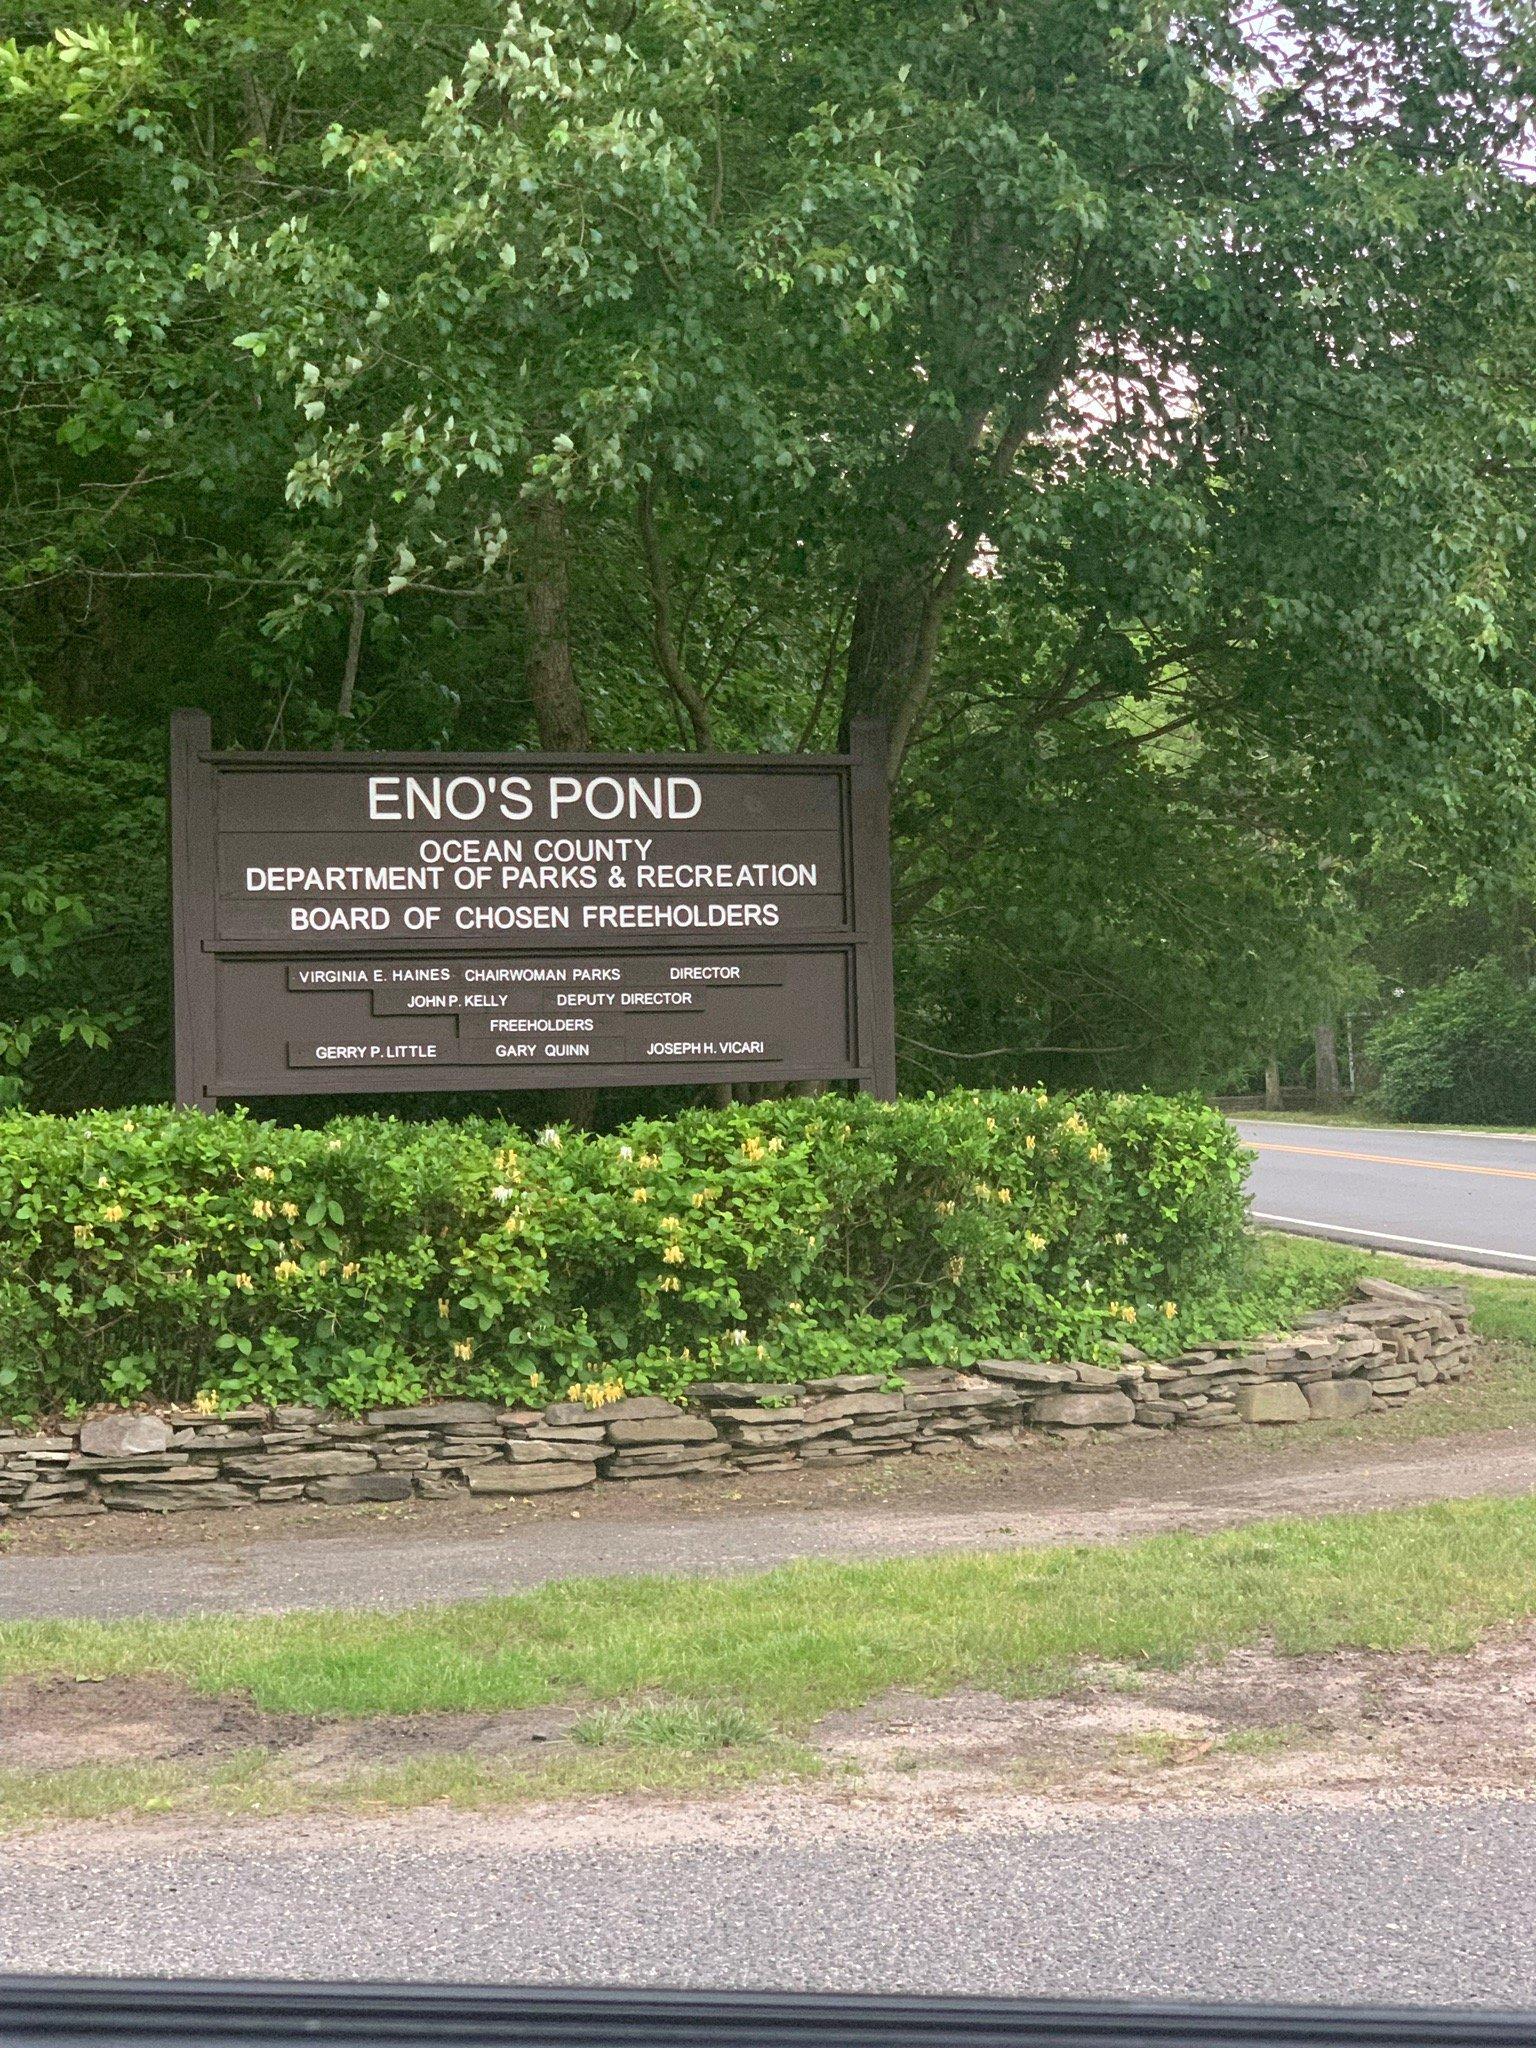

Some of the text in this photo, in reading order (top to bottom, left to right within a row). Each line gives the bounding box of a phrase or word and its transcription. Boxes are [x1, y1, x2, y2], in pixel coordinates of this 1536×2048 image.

[369, 777, 702, 820] ENO'S POND
[420, 839, 653, 863] OCEAN COUNTY
[247, 864, 816, 891] DEPARTMENT OF PARKS & RECREATION
[291, 904, 780, 930] BOARD OF CHOSEN FREEHOLDERS
[299, 967, 741, 983] VIRGINIA E. HAINES CHAIRWOMAN PARKS DIRECTOR
[407, 992, 692, 1008] JOHN P. KELLY DEPUTY DIRECTOR
[490, 1019, 594, 1032] FREEHOLDERS
[316, 1045, 437, 1059] GERRY P. LITTLE
[496, 1044, 590, 1057] GARY QUINN
[647, 1041, 764, 1055] JOSEPH H. VICARI
